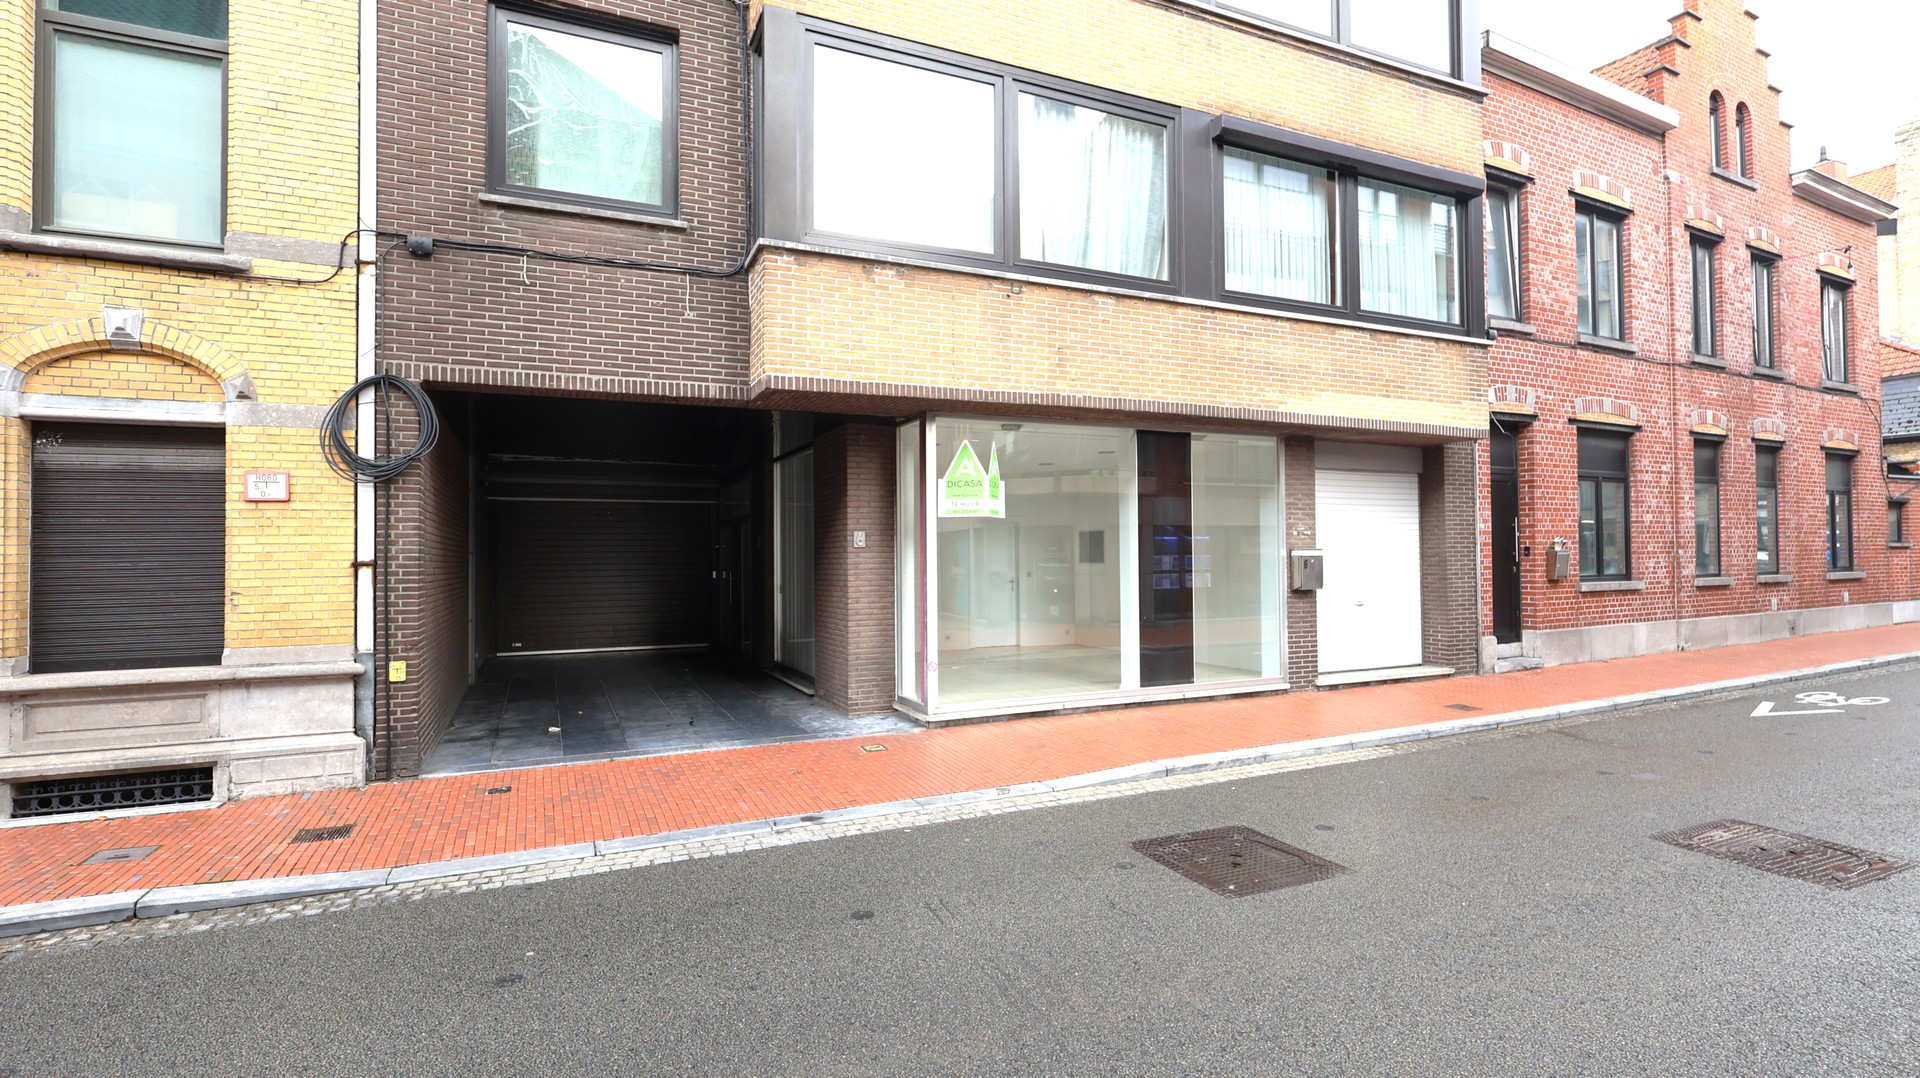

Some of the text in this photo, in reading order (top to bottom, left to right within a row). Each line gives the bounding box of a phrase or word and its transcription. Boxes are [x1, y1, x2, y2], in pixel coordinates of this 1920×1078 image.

[947, 480, 983, 488] DICASA
[855, 532, 864, 546] 6
[1303, 559, 1308, 569] 6
